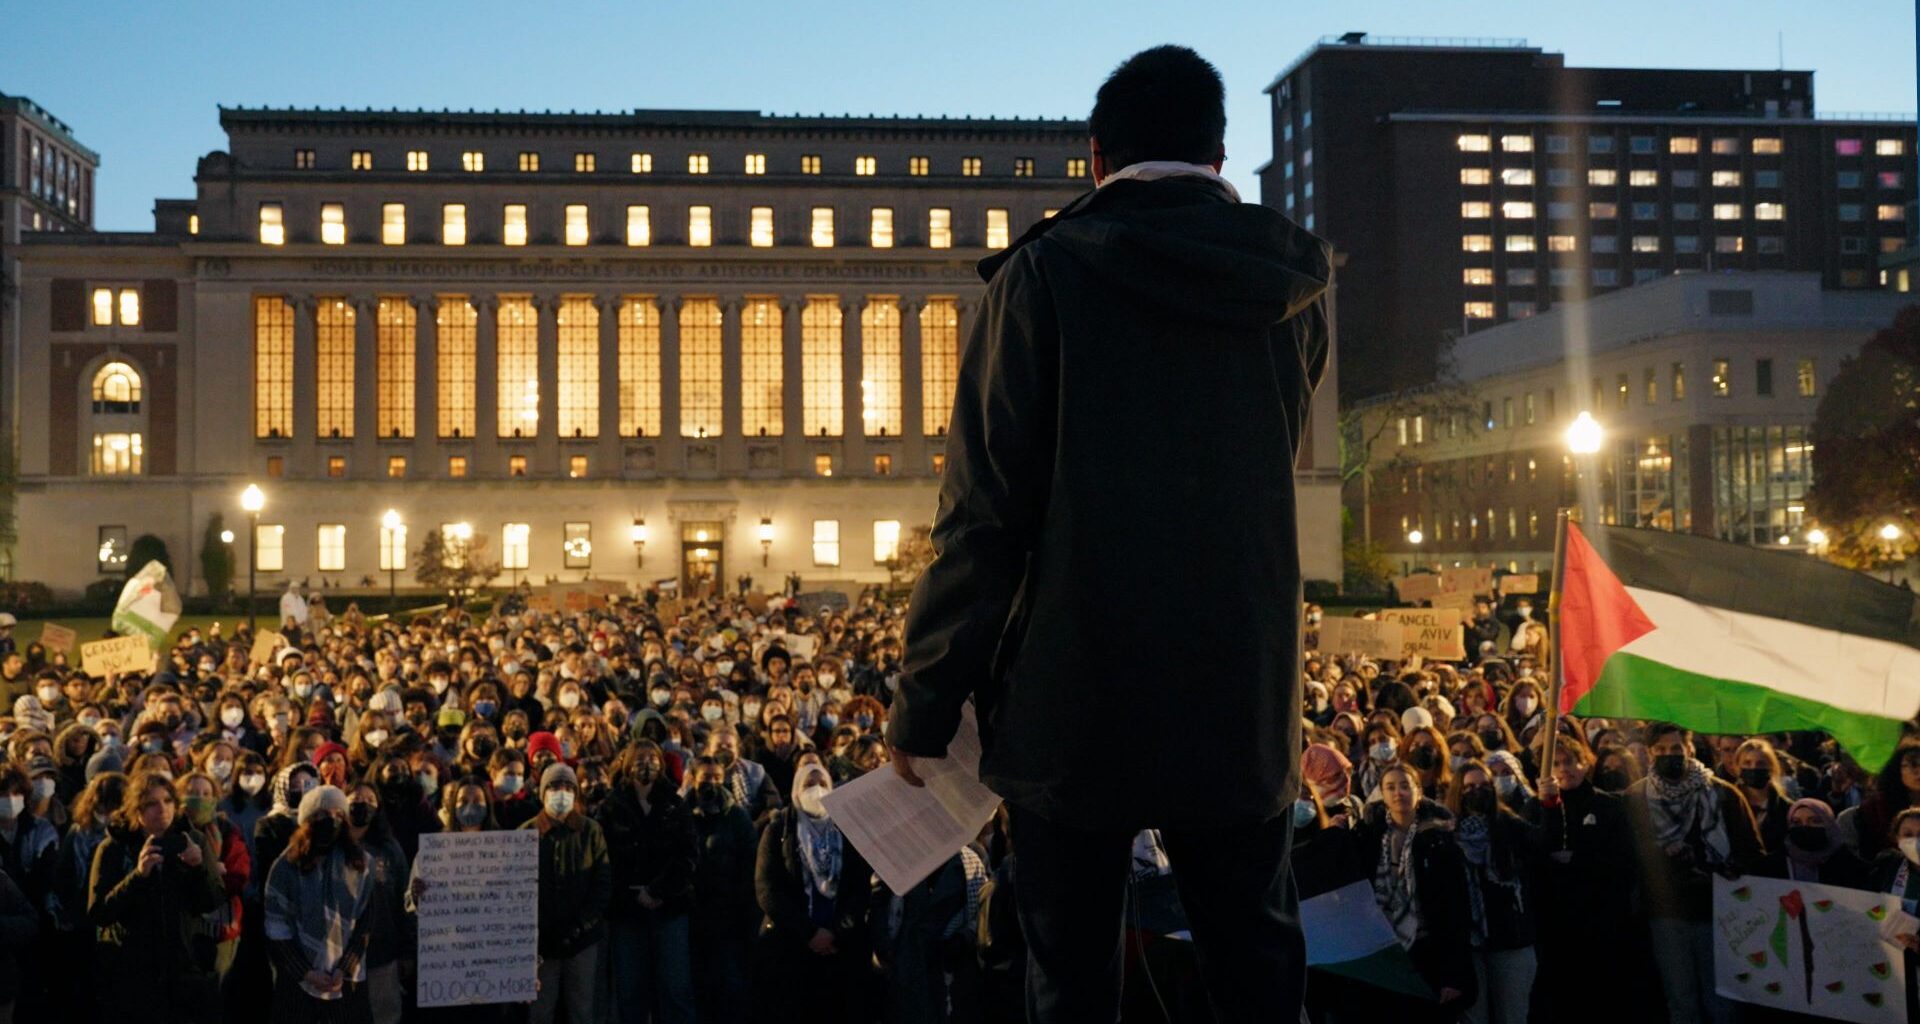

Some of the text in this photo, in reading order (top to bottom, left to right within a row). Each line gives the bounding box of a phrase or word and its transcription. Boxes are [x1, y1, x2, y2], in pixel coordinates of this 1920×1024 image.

[312, 263, 373, 275] HOMER
[387, 264, 496, 276] HERODOTUS
[511, 264, 610, 276] SOPHOCLES
[626, 264, 683, 277] PLATO
[699, 265, 792, 278] ARISTOTLE
[804, 266, 928, 278] DEMOSTHENES
[1386, 613, 1439, 626] CANCEL
[1420, 628, 1452, 640] AVIV
[499, 977, 534, 996] MORE
